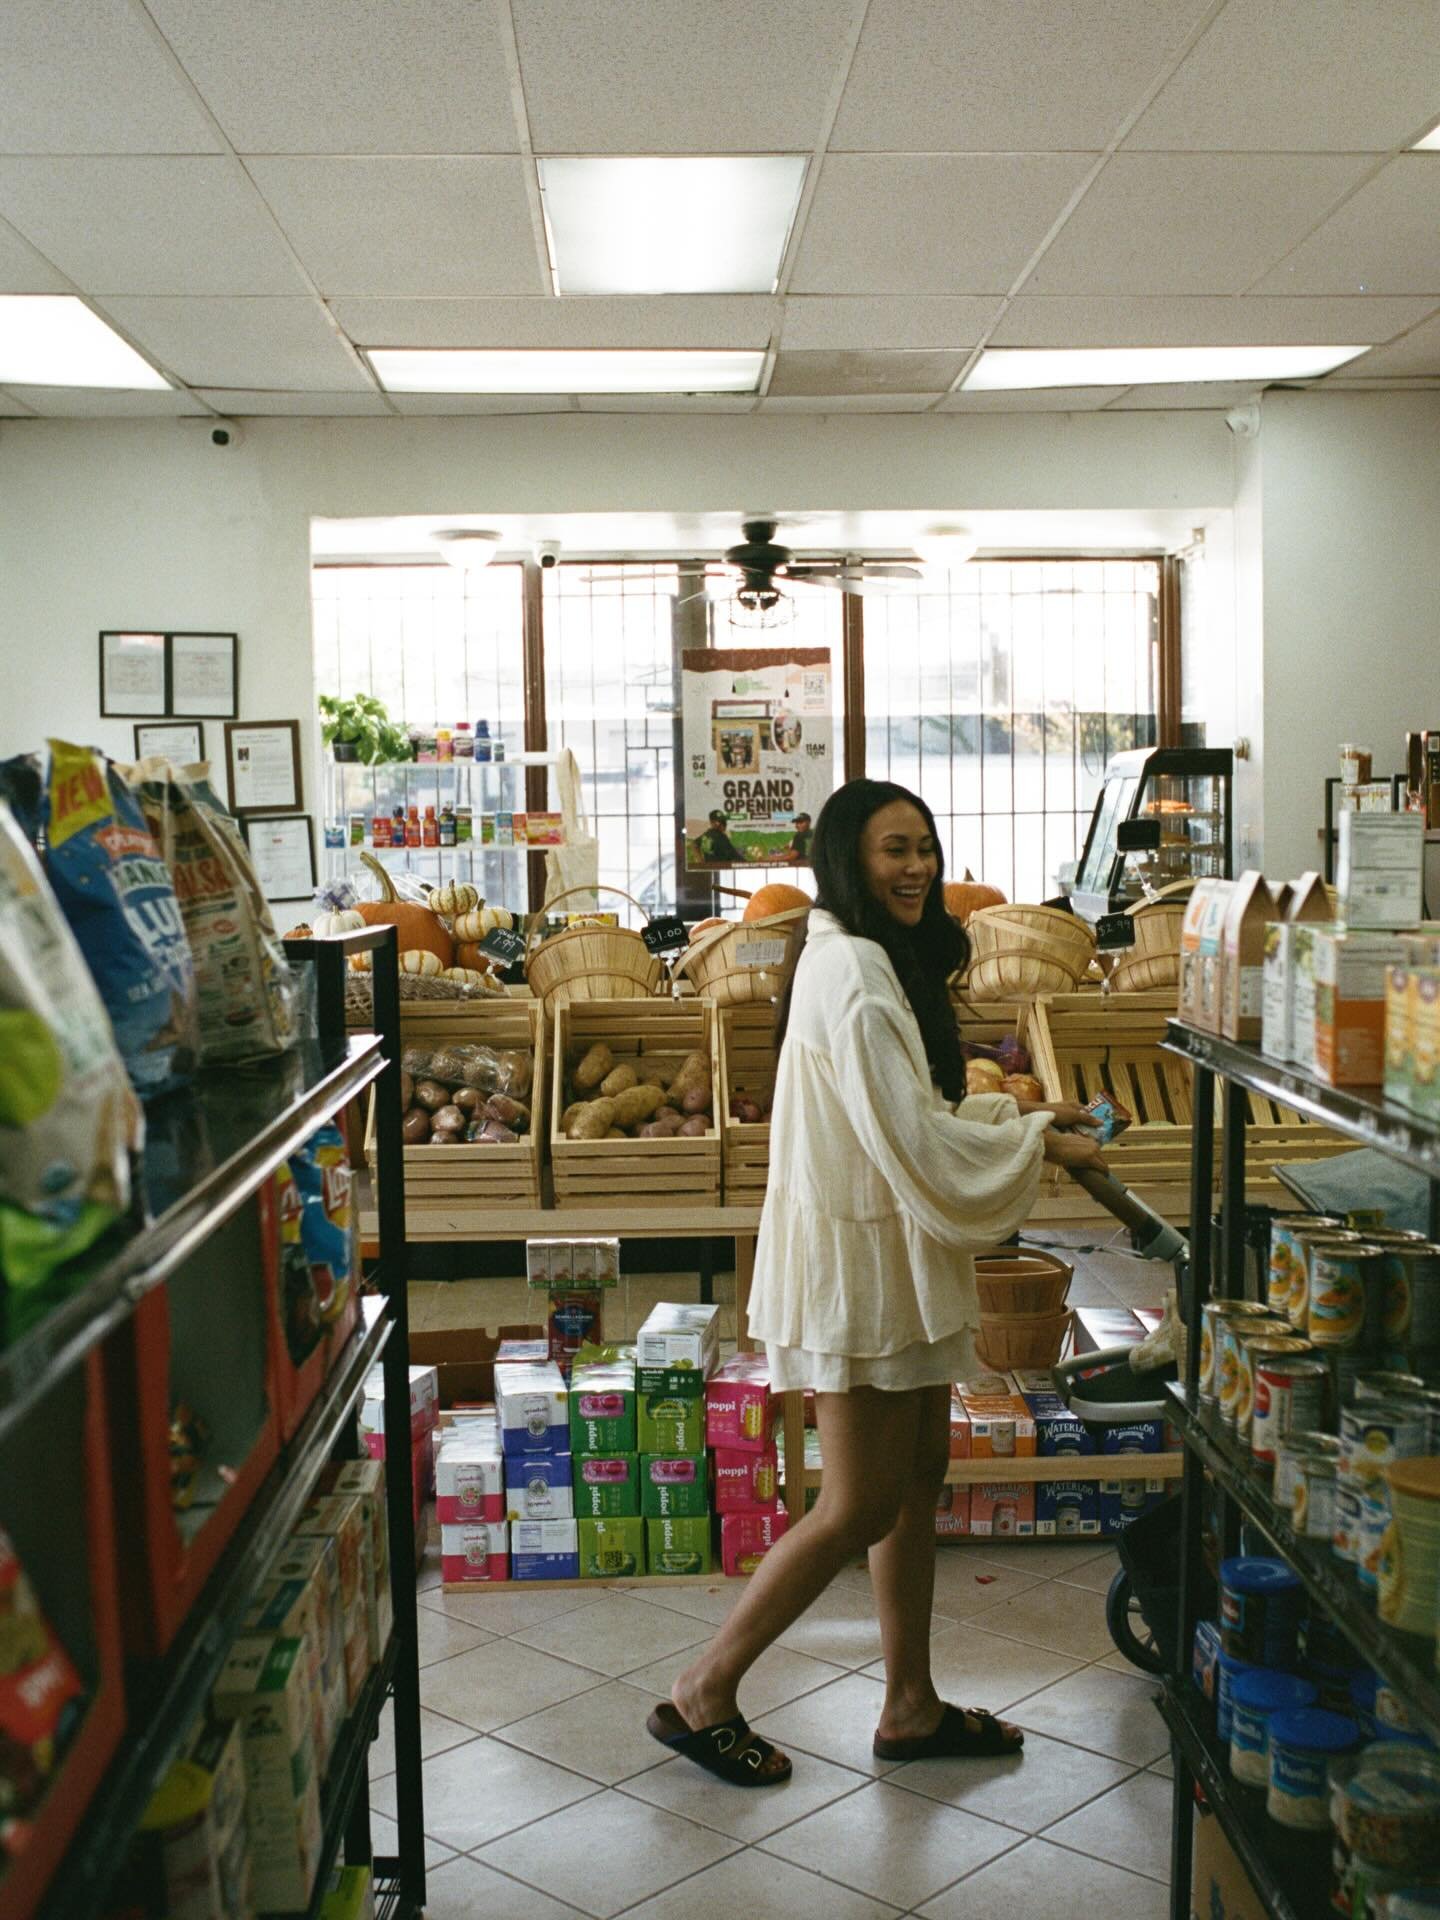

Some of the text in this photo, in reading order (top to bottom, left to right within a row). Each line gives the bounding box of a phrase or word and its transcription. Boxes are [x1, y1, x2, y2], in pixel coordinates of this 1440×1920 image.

[806, 743, 825, 751] 11AM
[692, 762, 706, 770] 04
[723, 779, 794, 798] GRAND
[723, 798, 794, 813] OPENING
[645, 927, 682, 945] $1.00
[707, 1401, 736, 1412] poppi
[585, 1420, 598, 1450] poppi
[675, 1421, 688, 1451] poppi
[1042, 1420, 1087, 1440] WATERLO
[717, 1465, 748, 1477] poppi
[588, 1486, 601, 1516] poppi
[657, 1486, 670, 1516] poppi
[662, 1519, 672, 1550] poppi
[762, 1516, 775, 1547] poppi
